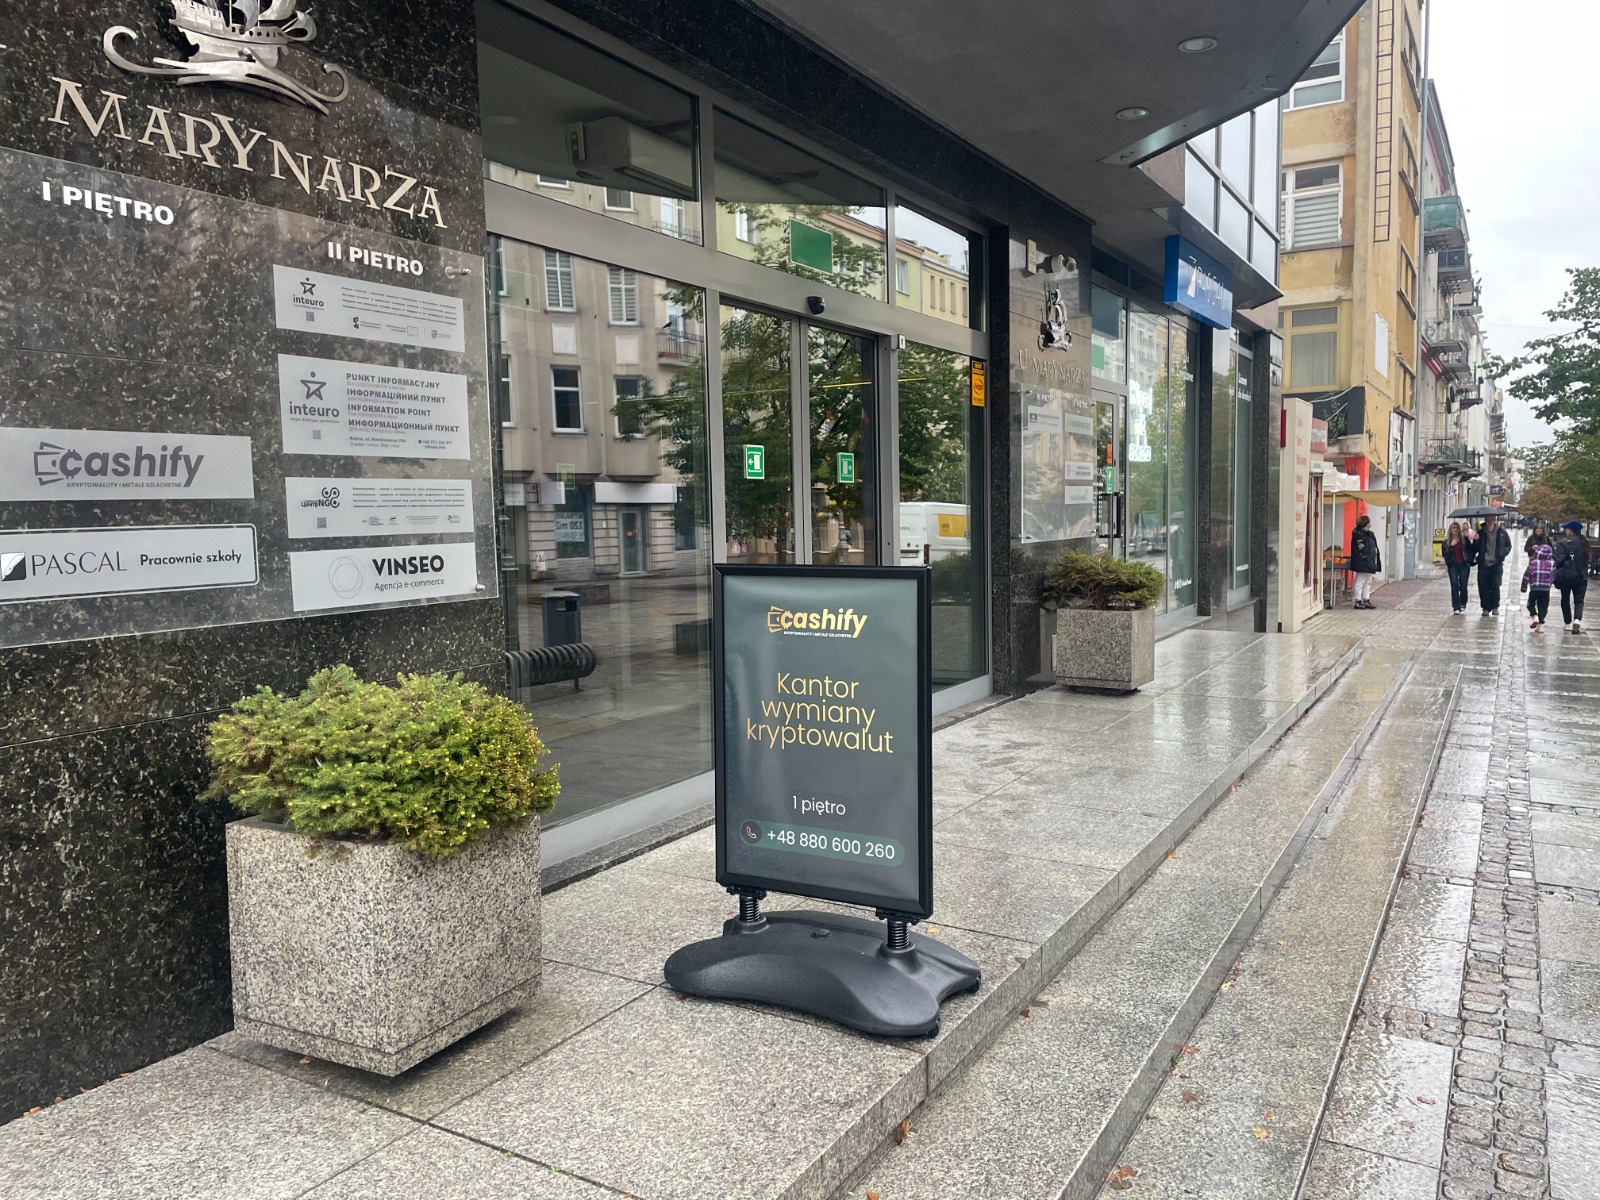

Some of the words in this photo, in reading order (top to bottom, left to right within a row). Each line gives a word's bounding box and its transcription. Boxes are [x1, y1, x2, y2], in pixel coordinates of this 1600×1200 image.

[48, 77, 447, 229] MARYNARZA
[42, 181, 52, 201] I
[63, 185, 174, 225] PIĘTRO
[327, 241, 342, 259] II
[350, 247, 424, 276] PIETRO
[293, 294, 325, 307] inteuro
[346, 372, 376, 383] PUNKT
[378, 375, 440, 389] INFORMACYJNY
[289, 401, 340, 418] inteuro
[347, 404, 406, 415] INFORMATION
[407, 408, 431, 417] POINT
[421, 395, 446, 404] ПУНКТ
[435, 424, 460, 433] ПУНКТ
[59, 444, 205, 487] cashify
[31, 551, 128, 577] PASCAL
[140, 552, 203, 566] Pracownie
[206, 549, 242, 564] szkoły
[372, 555, 445, 576] VINSEO
[374, 580, 403, 592] Agencja
[780, 608, 867, 638] cashify
[777, 672, 859, 699] Kantor
[761, 698, 876, 733] wymiany
[746, 717, 894, 754] kryptowalut
[801, 796, 846, 816] piętro
[767, 829, 795, 845] +48
[800, 833, 828, 850] 880
[832, 838, 861, 855] 600
[865, 842, 895, 860] 260
